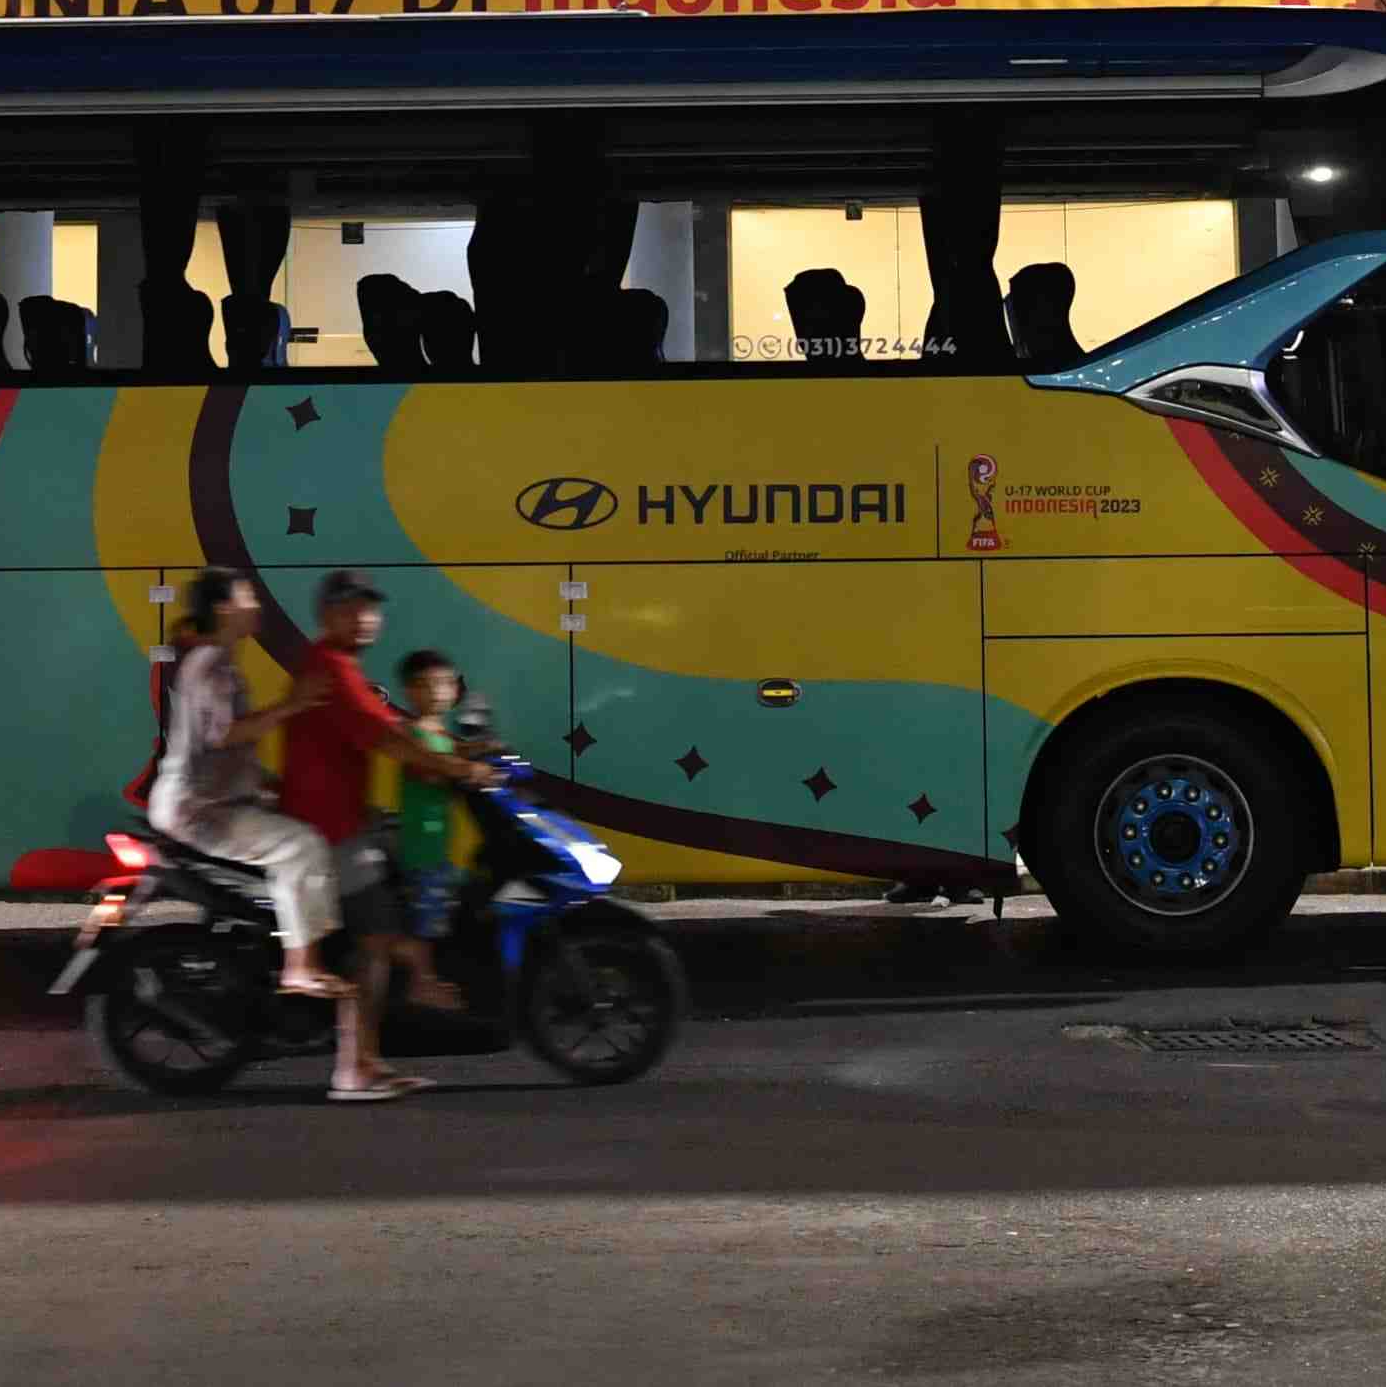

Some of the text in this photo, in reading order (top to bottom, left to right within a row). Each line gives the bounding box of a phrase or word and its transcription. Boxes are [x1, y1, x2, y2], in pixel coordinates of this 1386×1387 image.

[1004, 485, 1111, 496] U-17 WORLD CUP
[638, 483, 905, 525] HYUNDAI
[1005, 498, 1141, 517] INDONESIA 2023
[972, 537, 996, 547] FIFA
[724, 549, 820, 561] Official Partner
